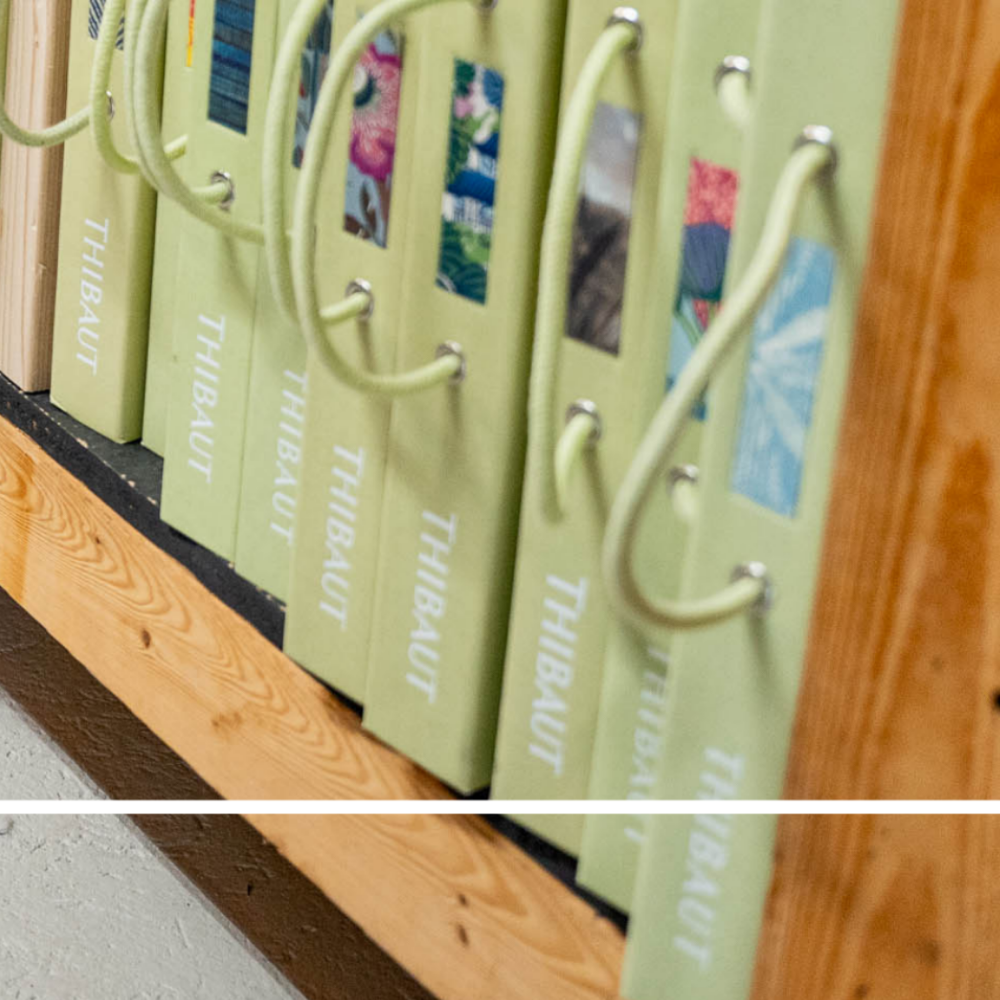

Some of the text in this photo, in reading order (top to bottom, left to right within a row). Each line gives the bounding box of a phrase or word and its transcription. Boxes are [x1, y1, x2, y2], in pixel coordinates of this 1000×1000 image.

[75, 216, 110, 377] THIBAUT
[186, 312, 226, 485] THIBAUT
[269, 367, 310, 547] THIBAUT
[319, 444, 365, 633] THIBAUT
[404, 508, 459, 705] THIBAUT
[528, 573, 590, 777] THIBAUT
